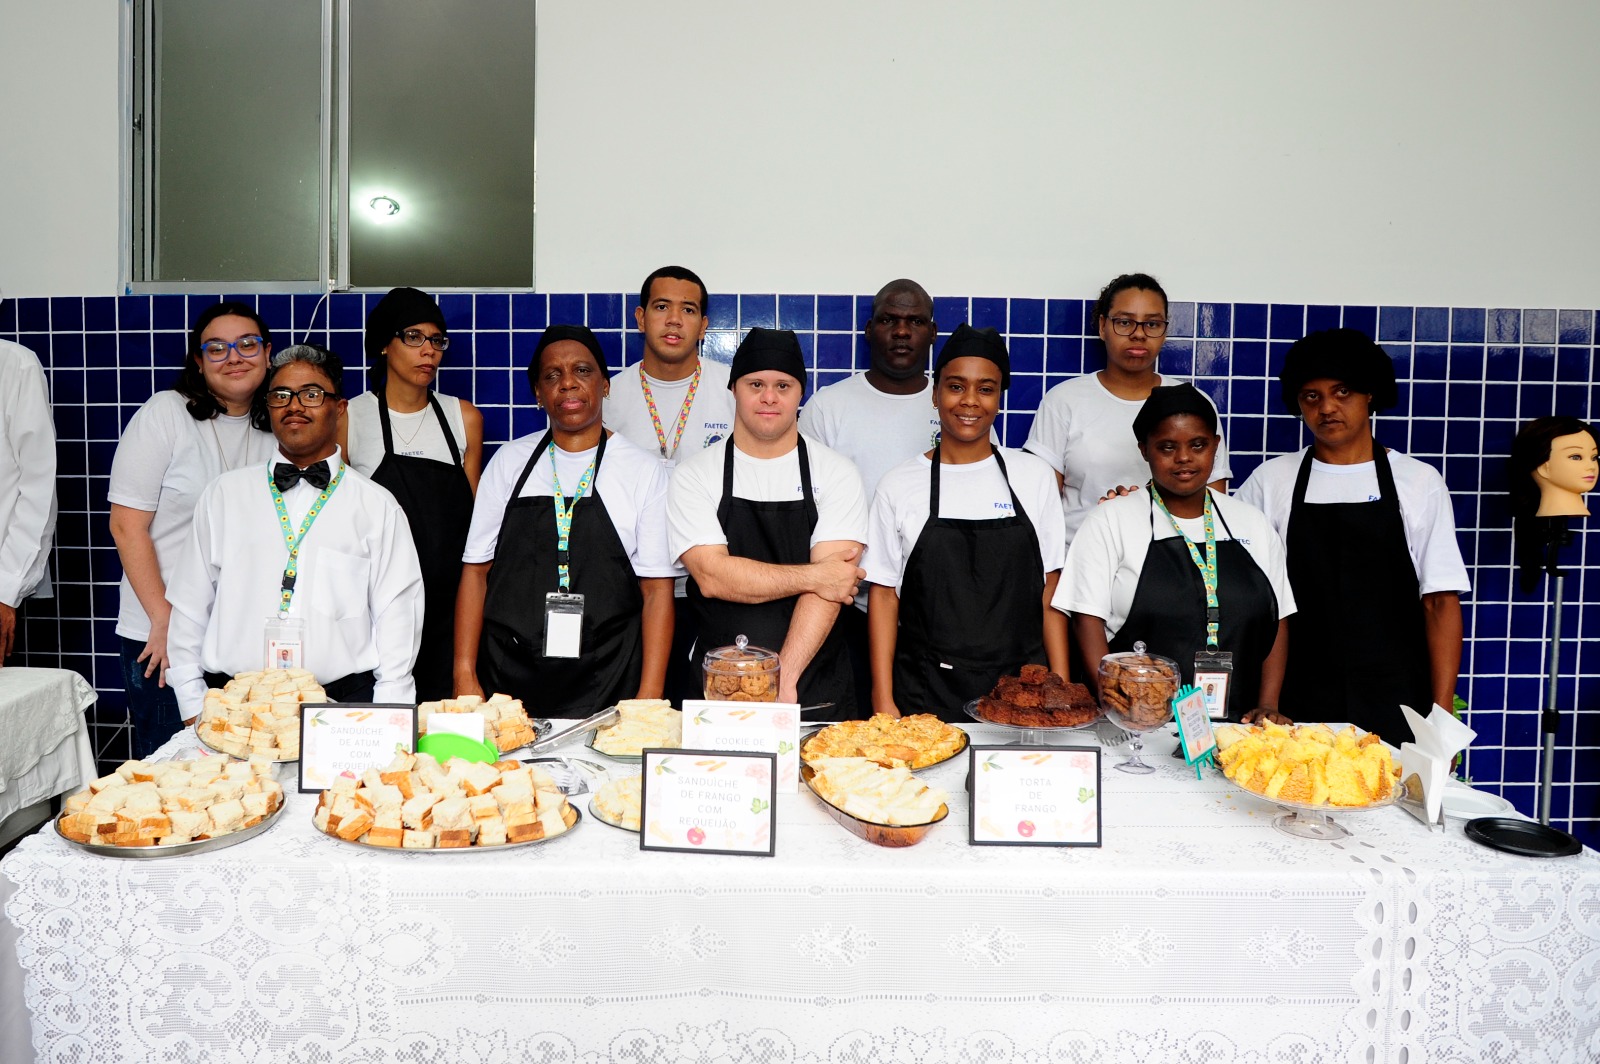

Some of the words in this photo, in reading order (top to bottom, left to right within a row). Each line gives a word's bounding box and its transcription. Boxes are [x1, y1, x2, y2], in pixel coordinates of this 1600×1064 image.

[704, 422, 728, 430] FAETEC
[339, 738, 351, 746] DE
[354, 738, 380, 747] ATUM
[715, 737, 750, 746] COOKIE
[753, 738, 765, 746] DE
[350, 750, 371, 758] COM
[1019, 778, 1052, 787] TORTA
[681, 790, 694, 799] DE
[698, 791, 741, 803] FRANGO
[1029, 791, 1042, 800] DE
[698, 805, 722, 814] COM
[1015, 804, 1057, 813] FRANGO
[679, 816, 737, 830] REQUEIJÃO
